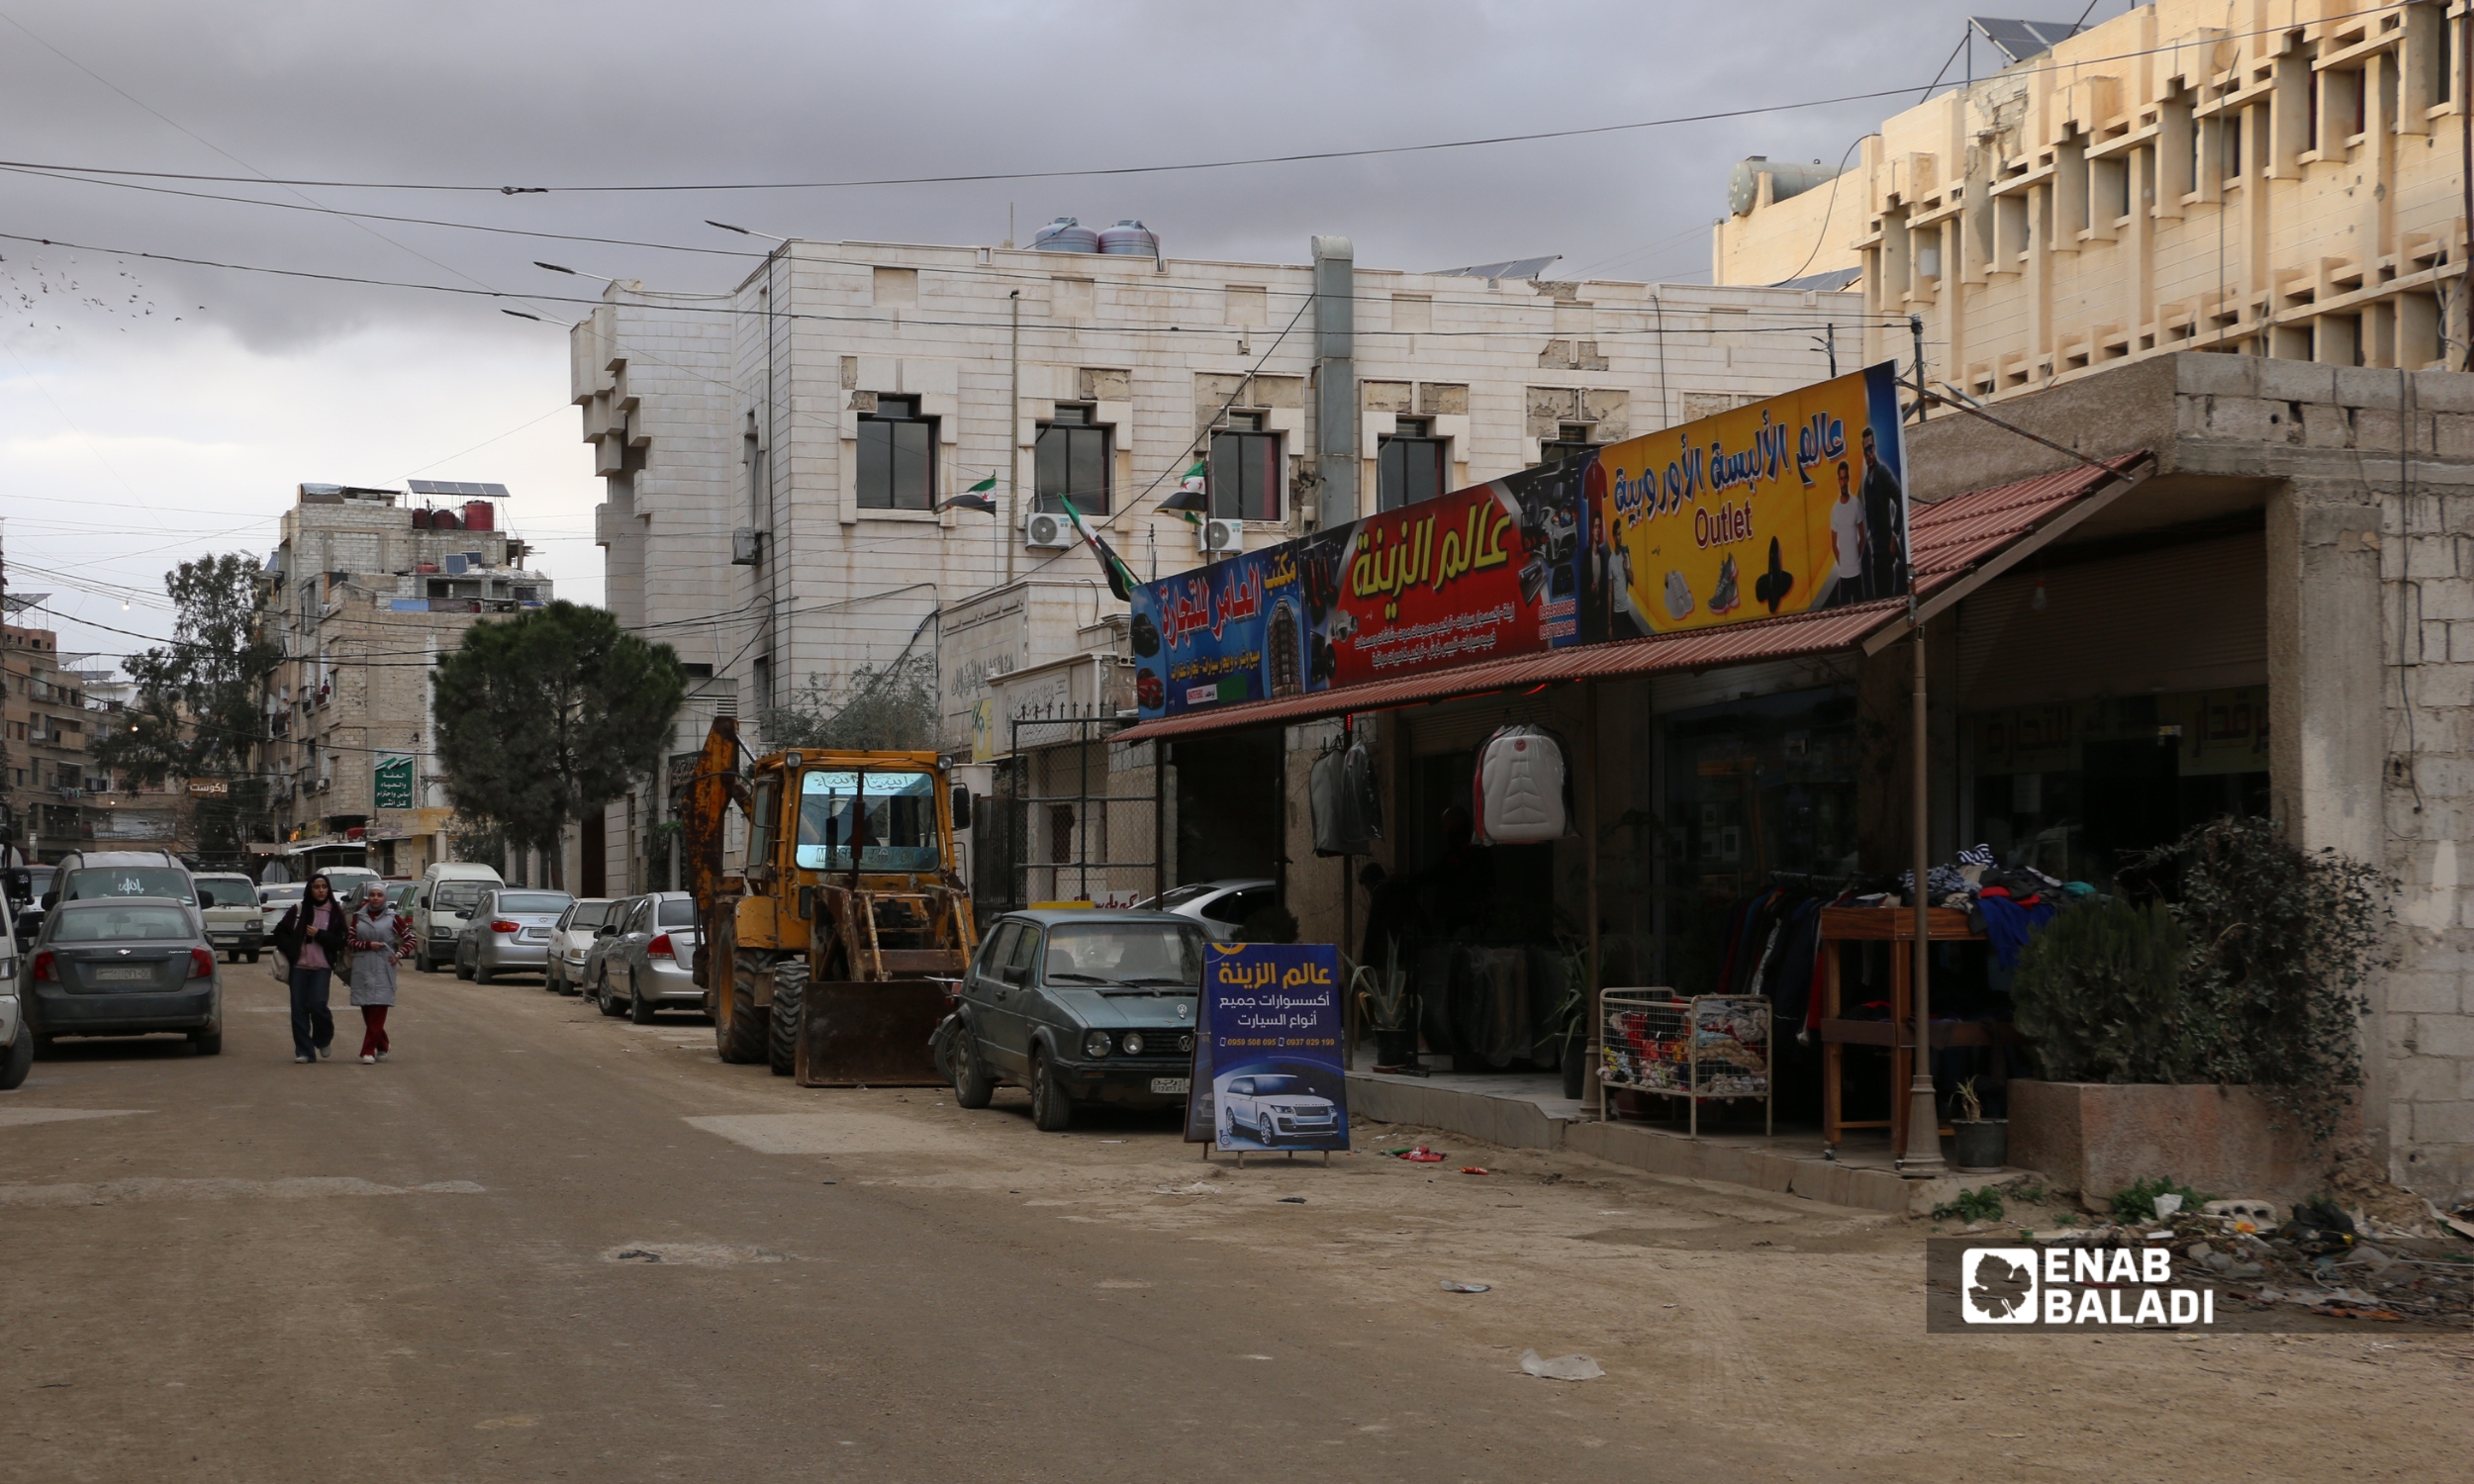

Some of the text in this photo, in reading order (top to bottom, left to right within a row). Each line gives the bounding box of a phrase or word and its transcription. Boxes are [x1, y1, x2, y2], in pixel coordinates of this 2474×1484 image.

[1613, 408, 1846, 529] عالم الألبسة الأوروبية
[1694, 497, 1754, 550] Outlet
[1352, 497, 1512, 621] عالم الزينة
[1161, 551, 1298, 651] مكتب العامر للتجارة
[1538, 598, 1576, 620] 0959508095
[1539, 618, 1576, 641] 0937029199
[189, 783, 228, 793] لاكوست
[1219, 962, 1331, 989] عالم الزينة
[1219, 991, 1329, 1009] أكسسوارات جميع
[1238, 1010, 1317, 1028] أنواع السيارت
